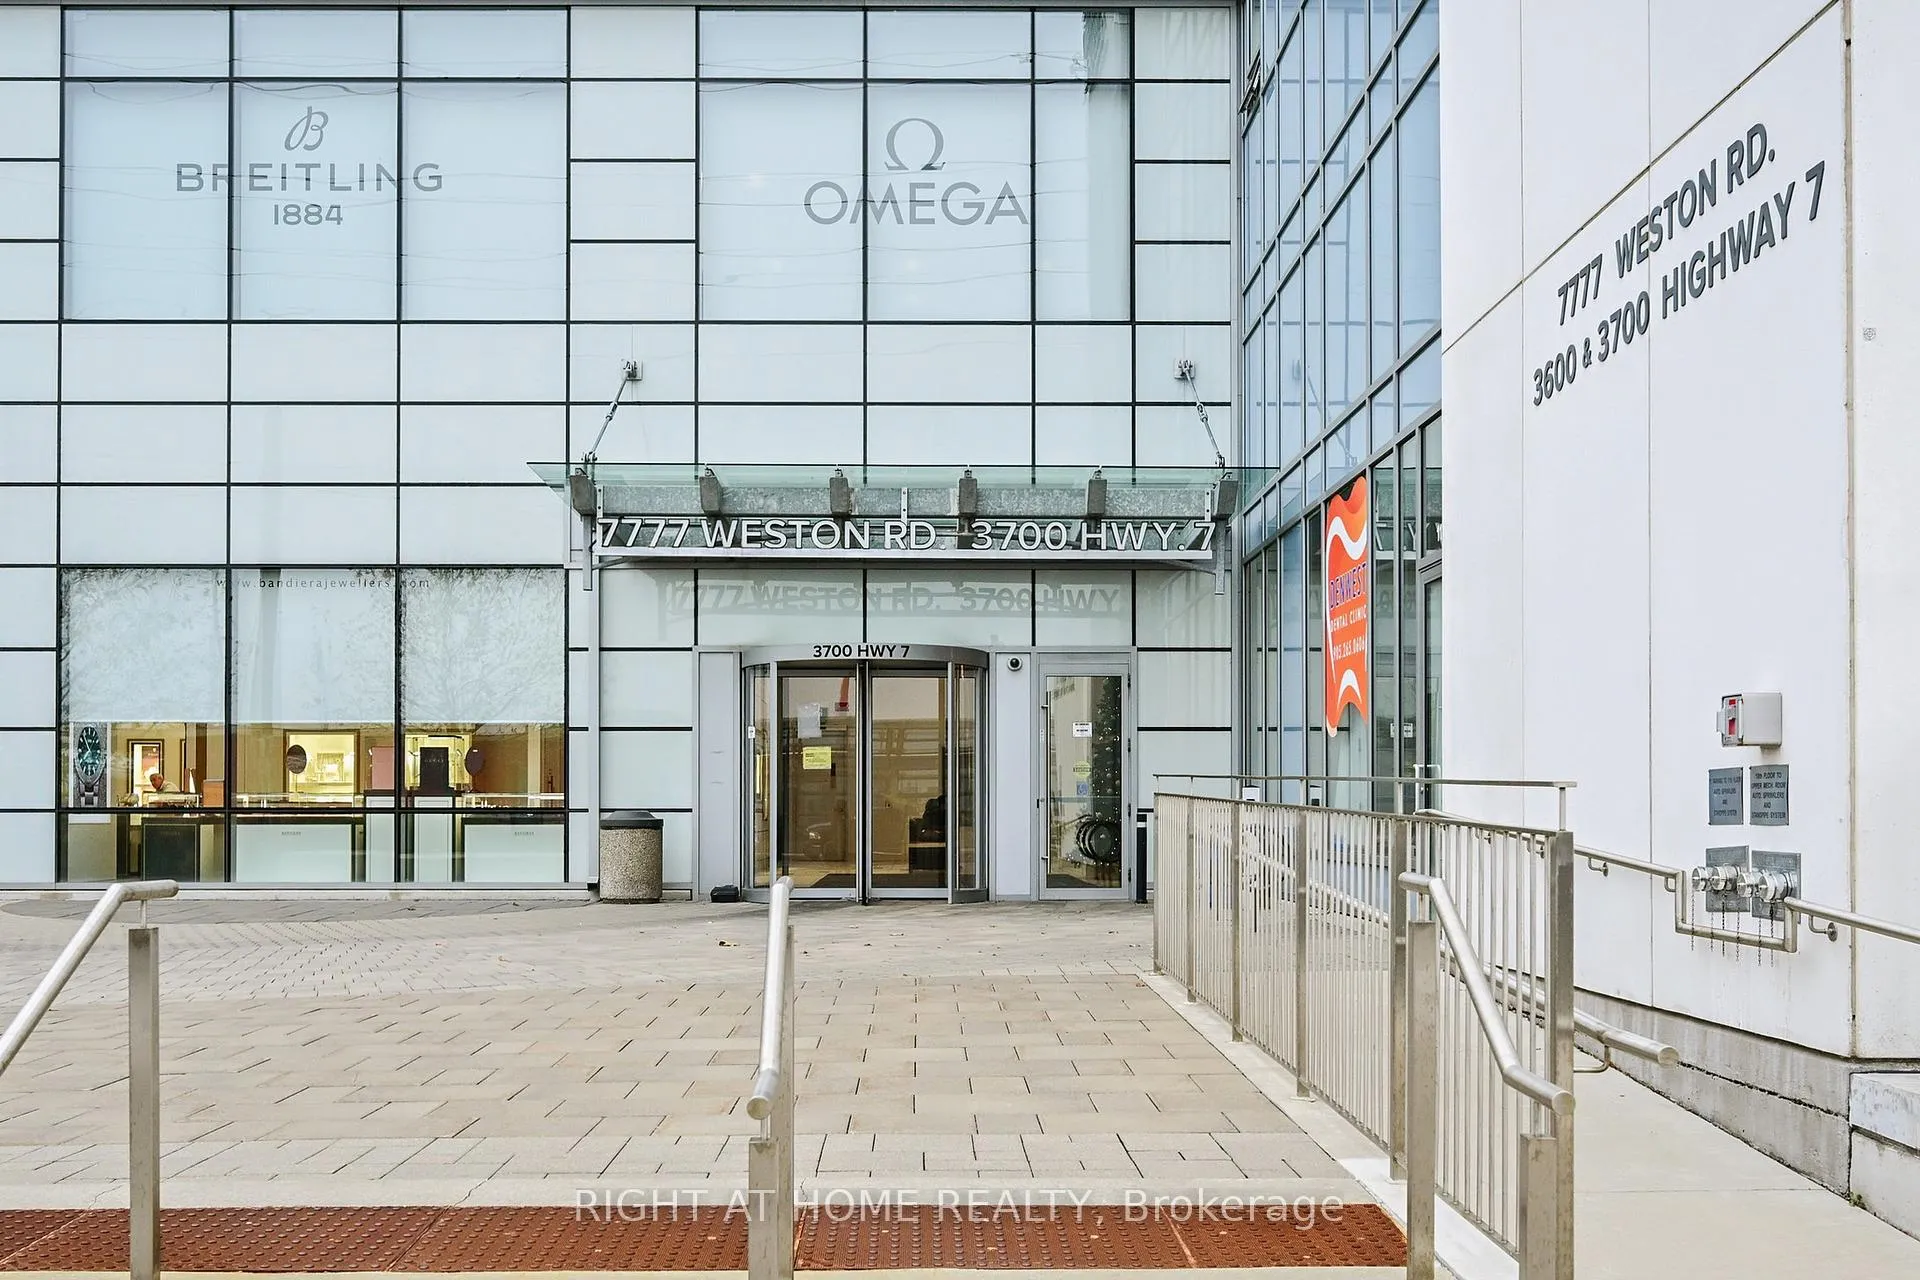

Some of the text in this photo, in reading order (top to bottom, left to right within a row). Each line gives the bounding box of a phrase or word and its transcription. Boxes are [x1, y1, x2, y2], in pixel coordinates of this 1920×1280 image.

[176, 163, 442, 192] BREITLING
[273, 204, 343, 226] 1884
[804, 181, 1029, 225] OMEGA
[1557, 123, 1776, 326] 7777 WESTON RD.
[1533, 160, 1826, 407] 3600 & 3700 HIGHWAY 7
[598, 518, 1217, 551] 7777 WESTON RD. 3700 HWY. 7
[216, 577, 429, 590] ww.bandierajewellerscom
[1330, 562, 1367, 610] DENWEST
[813, 644, 910, 658] 3700 HWY 7
